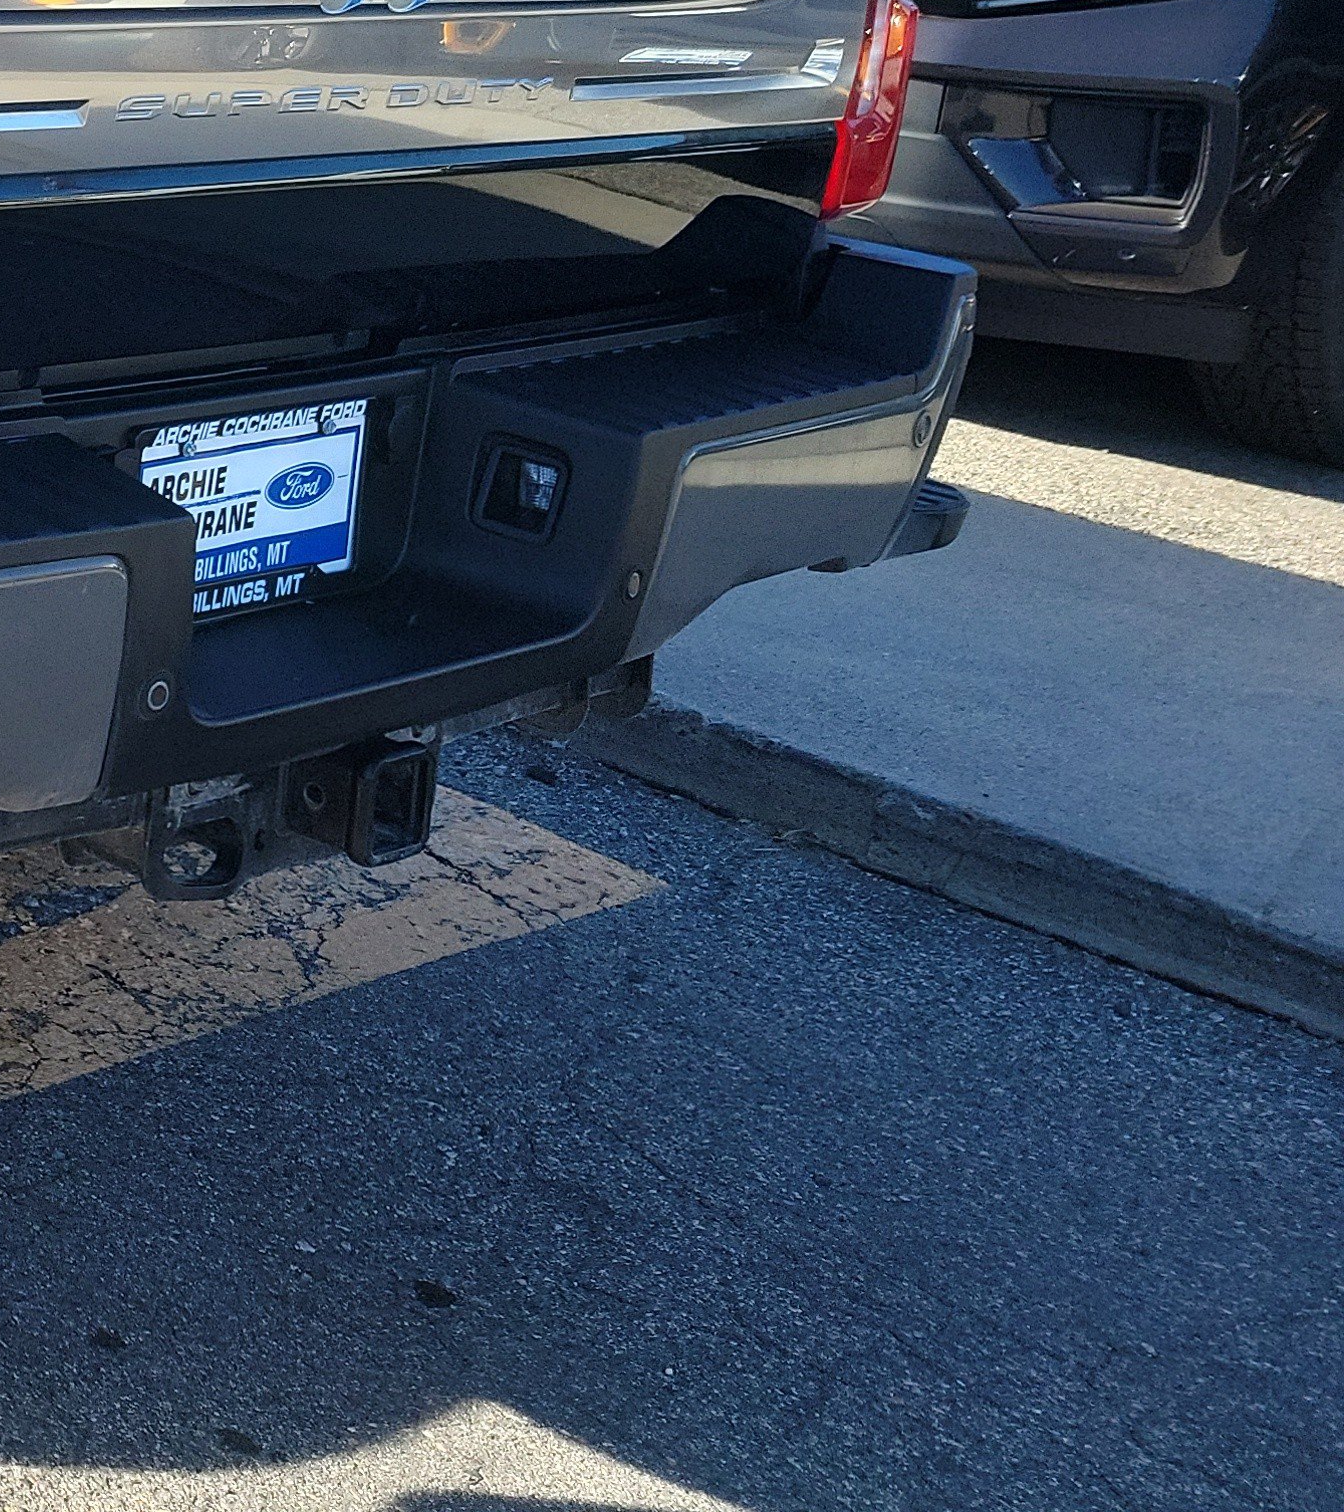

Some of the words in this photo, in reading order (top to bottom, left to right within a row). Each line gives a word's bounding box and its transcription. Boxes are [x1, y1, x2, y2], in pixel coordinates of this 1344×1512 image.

[114, 84, 371, 122] SUPER
[385, 76, 555, 109] DUTY
[152, 421, 220, 448] ARCHIE
[222, 406, 318, 437] COCHRANE
[320, 399, 368, 423] FORD
[280, 471, 323, 500] Ford
[194, 546, 262, 582] BILLINGS,
[266, 541, 291, 566] MT
[275, 573, 305, 597] MT
